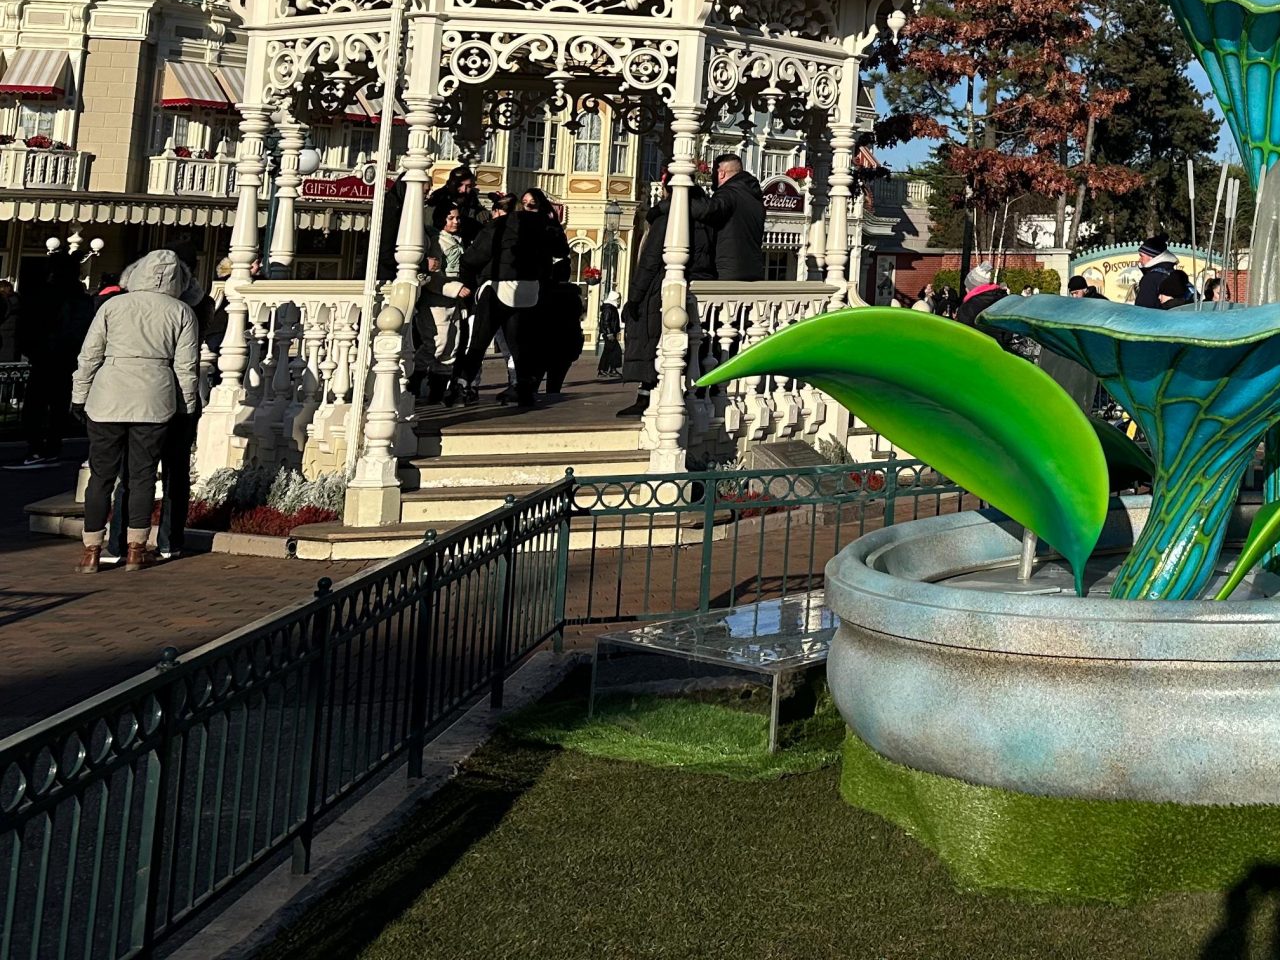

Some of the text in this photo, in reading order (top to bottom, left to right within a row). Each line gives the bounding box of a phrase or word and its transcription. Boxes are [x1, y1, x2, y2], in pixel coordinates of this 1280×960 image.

[304, 182, 374, 198] GIFTS for ALL
[762, 193, 798, 209] Electric
